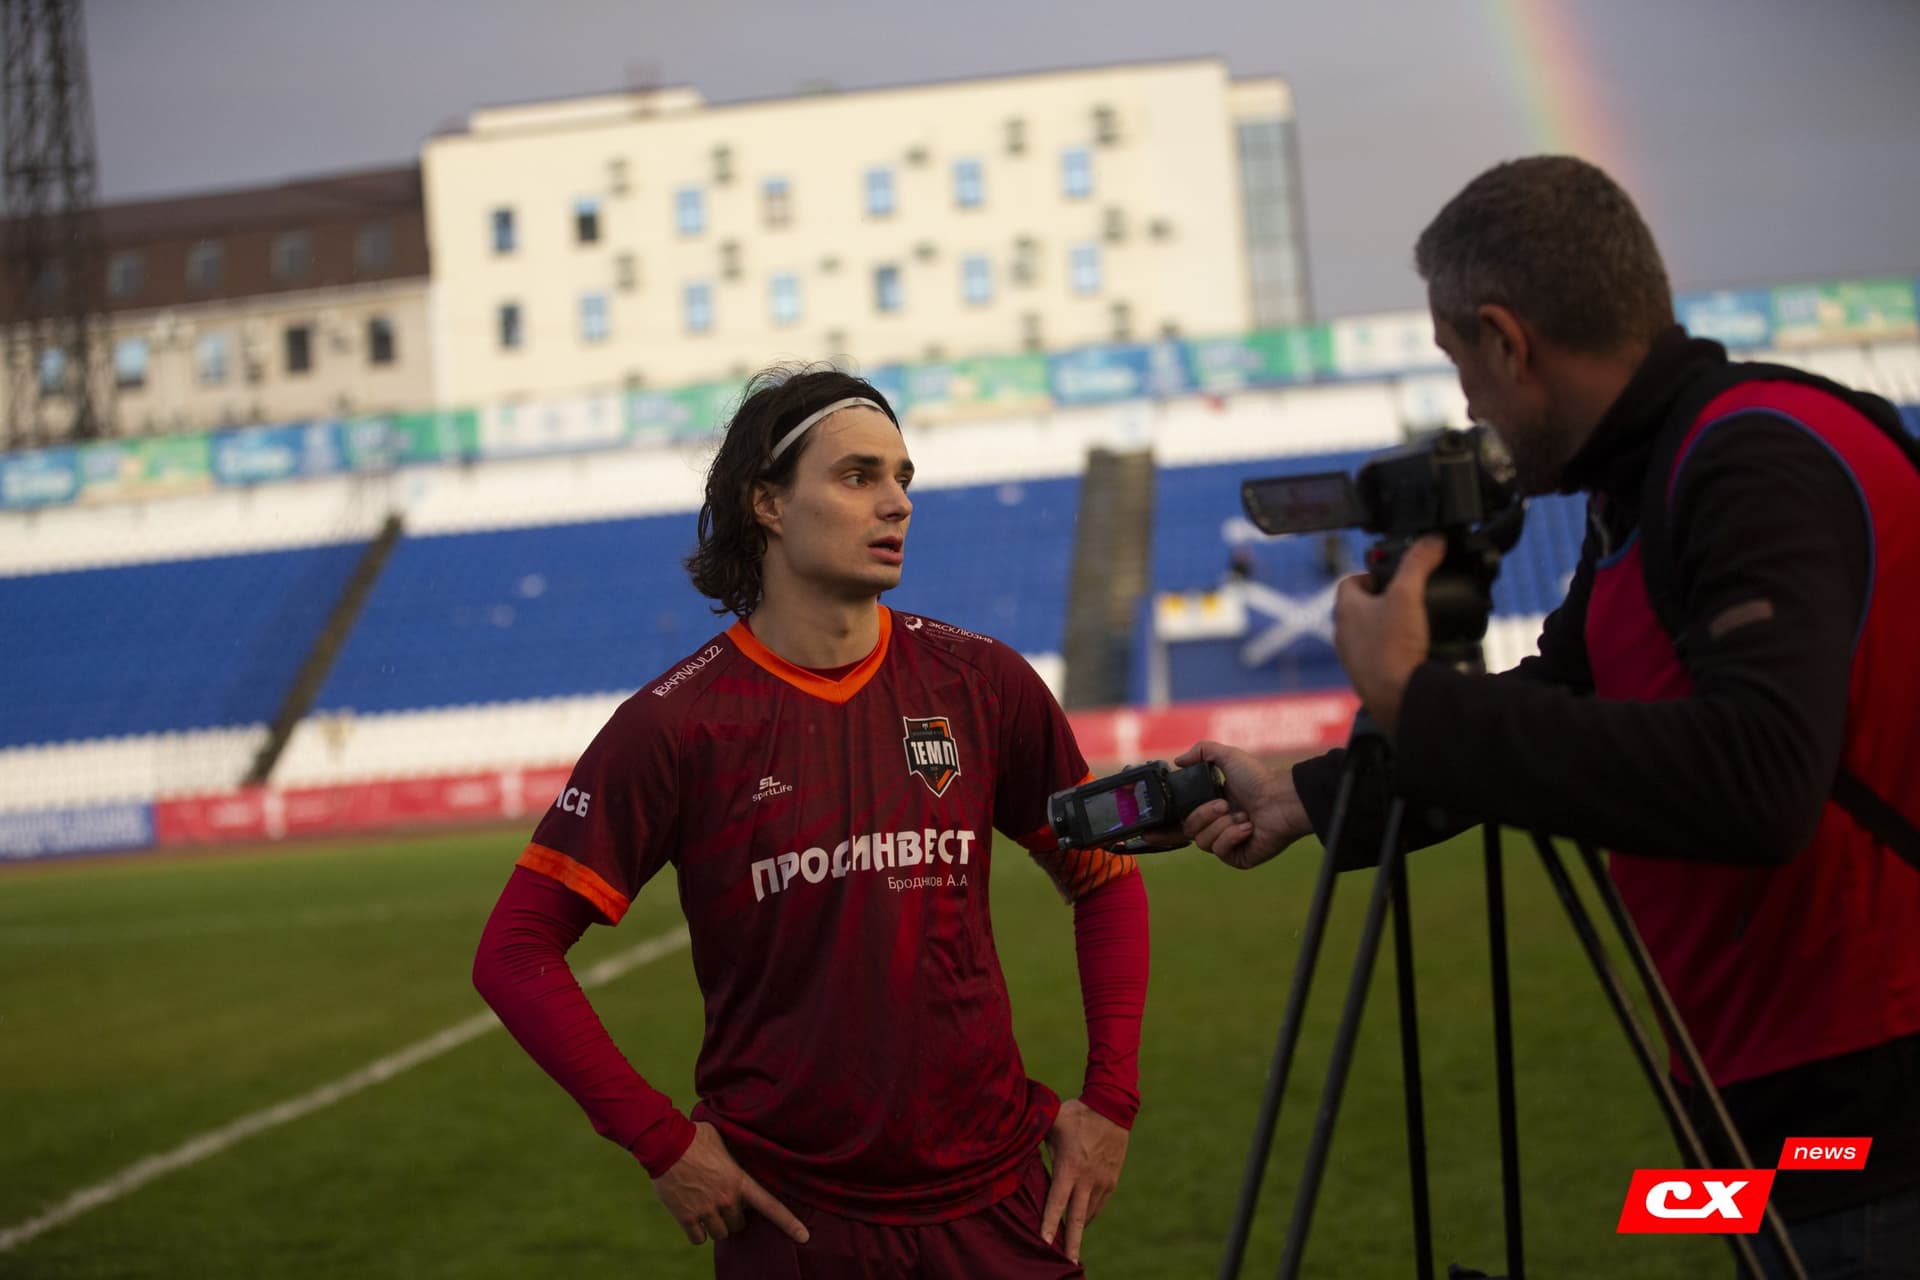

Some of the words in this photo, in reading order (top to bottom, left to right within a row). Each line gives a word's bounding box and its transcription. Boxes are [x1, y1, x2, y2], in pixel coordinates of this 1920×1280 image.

[927, 621, 993, 644] ЭКСКЛЮЗИВ
[910, 740, 956, 767] ТЕМП
[759, 775, 781, 790] SL
[751, 828, 976, 902] ПРОДИНВЕСТ
